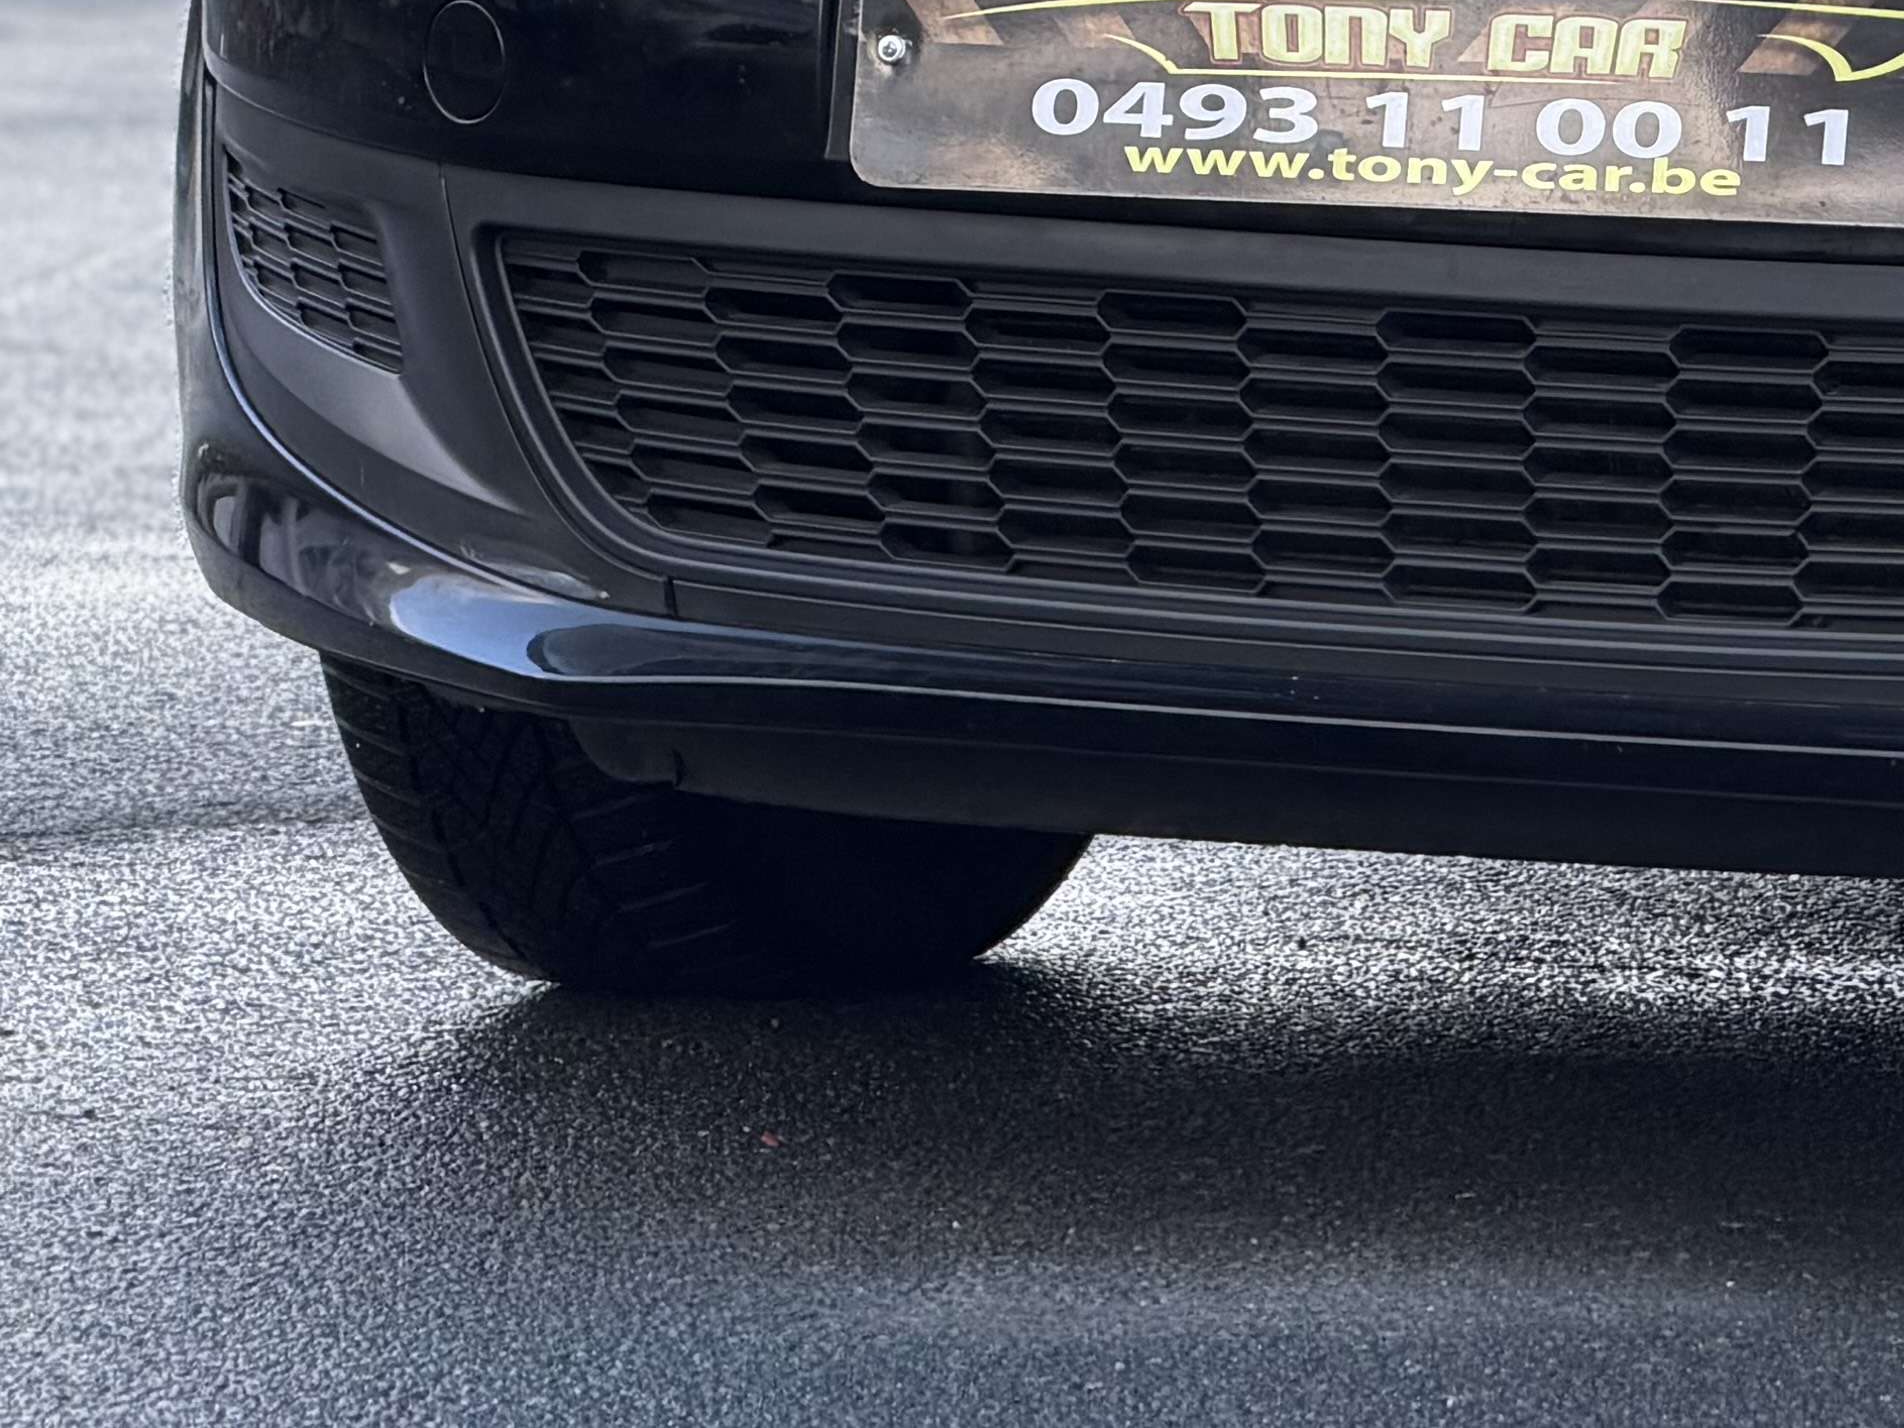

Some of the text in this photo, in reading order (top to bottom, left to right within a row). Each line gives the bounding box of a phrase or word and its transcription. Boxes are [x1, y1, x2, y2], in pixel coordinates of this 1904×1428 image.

[1180, 0, 1690, 80] TONY CAR
[1031, 77, 1850, 166] 0493 11 00 11
[1123, 145, 1742, 196] www.tony-car.be
